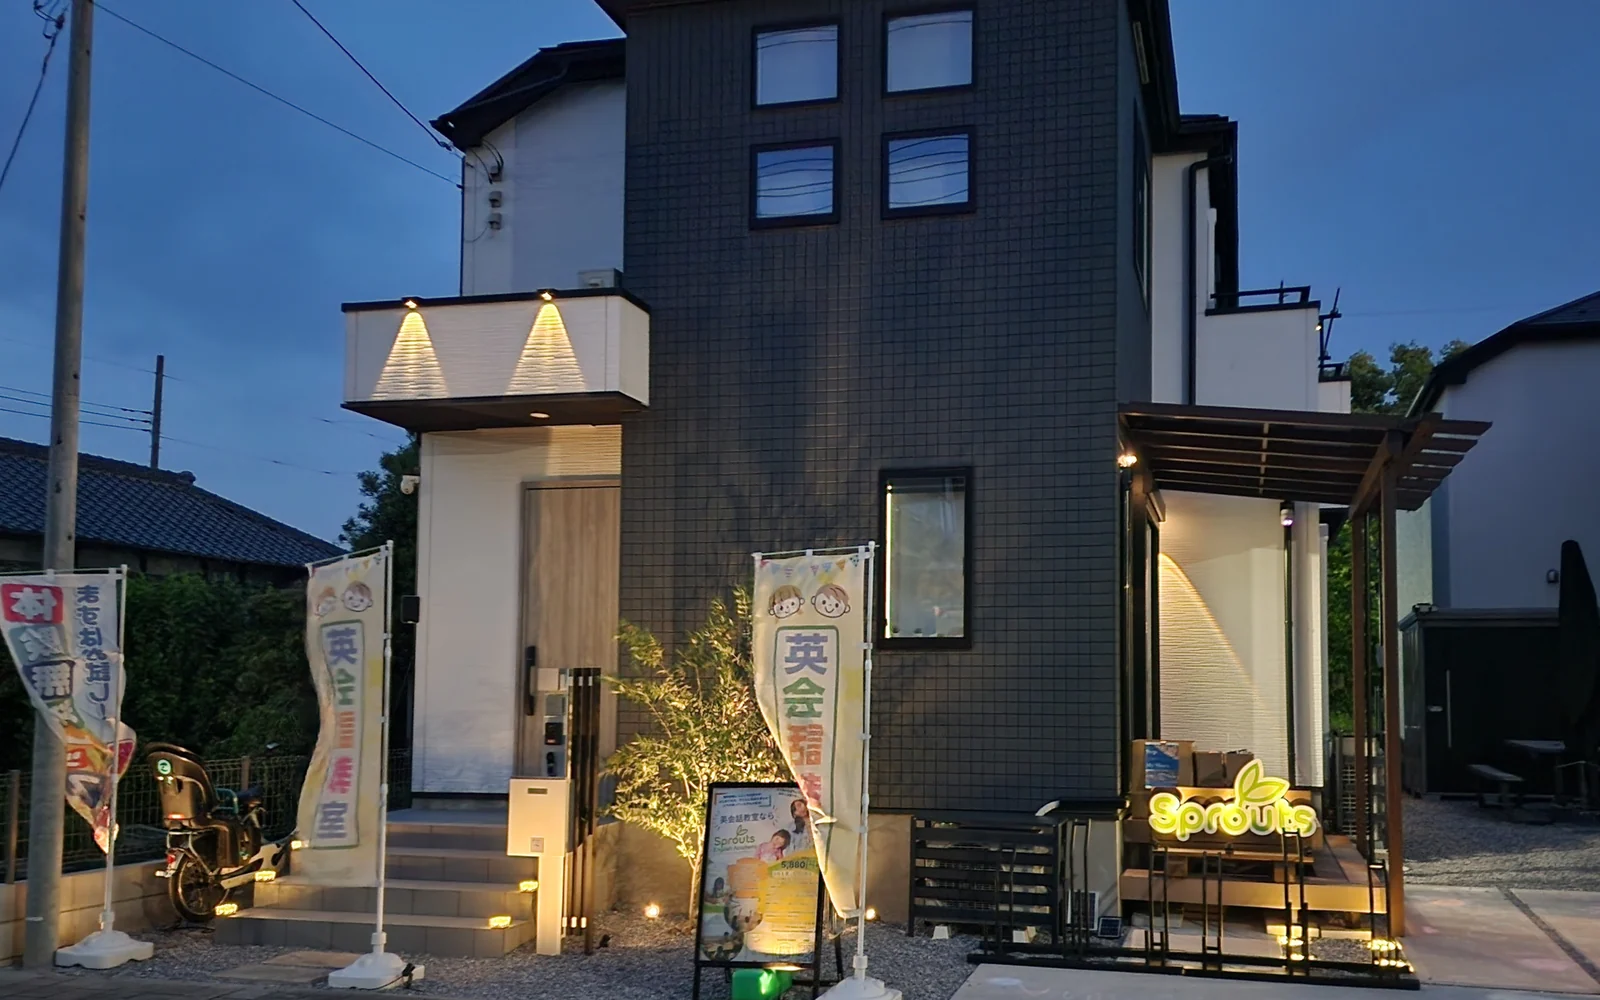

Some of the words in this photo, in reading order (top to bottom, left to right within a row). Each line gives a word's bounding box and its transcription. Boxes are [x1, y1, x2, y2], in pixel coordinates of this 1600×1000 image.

[720, 812, 774, 823] 英会話教室なら
[1149, 792, 1317, 842] Sprouts
[714, 834, 755, 848] Sprouts
